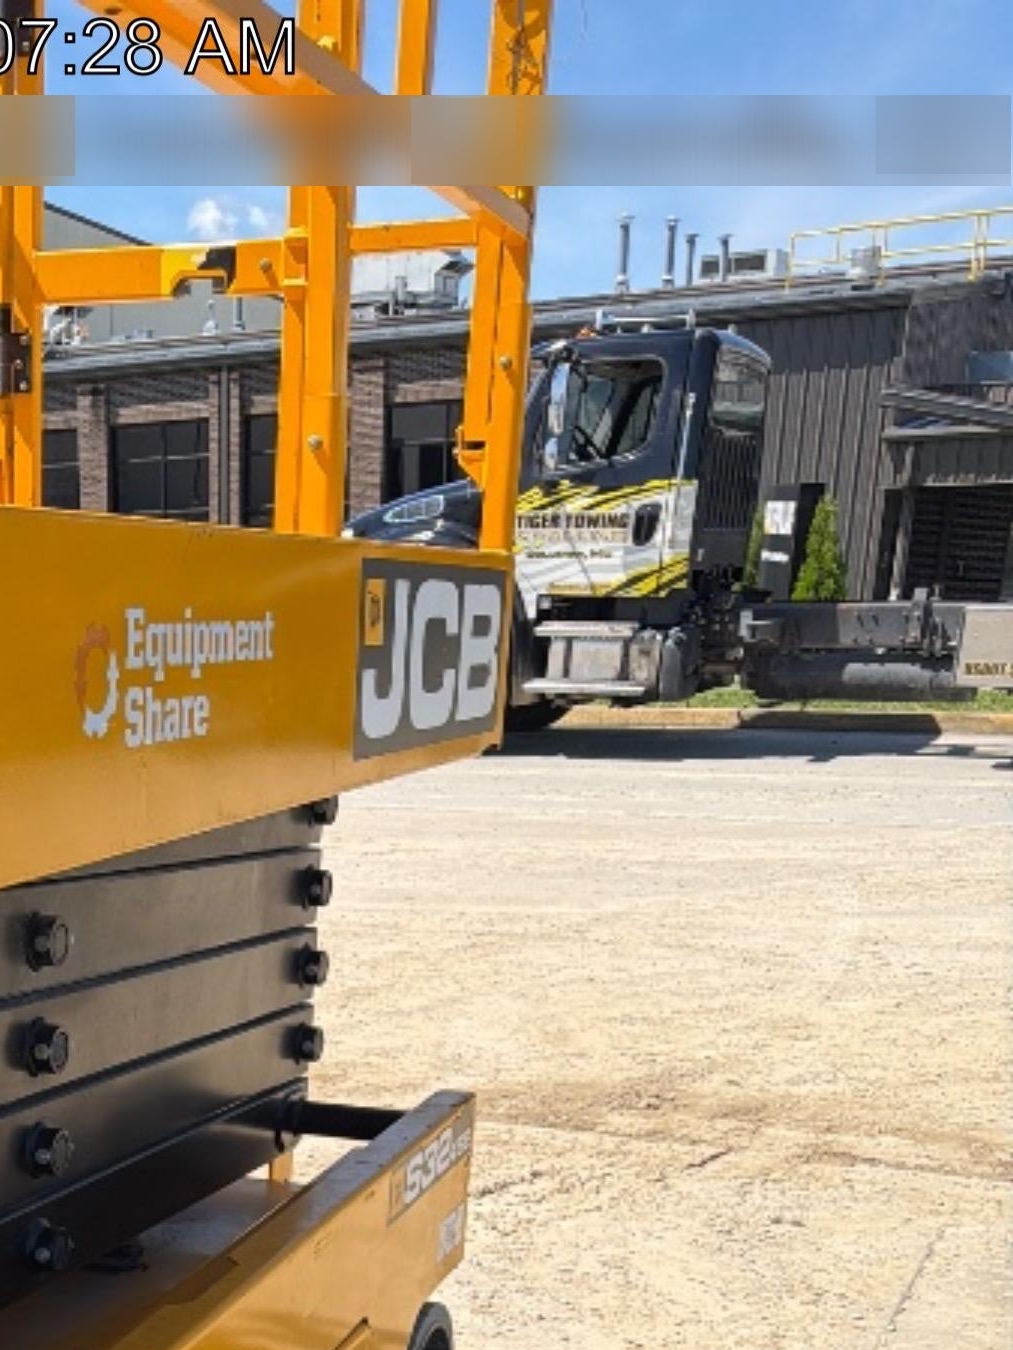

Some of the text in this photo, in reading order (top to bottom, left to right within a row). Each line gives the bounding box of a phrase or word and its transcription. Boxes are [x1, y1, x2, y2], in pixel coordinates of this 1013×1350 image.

[124, 607, 275, 681] Equipment
[361, 578, 502, 740] JCB
[124, 686, 211, 748] Share
